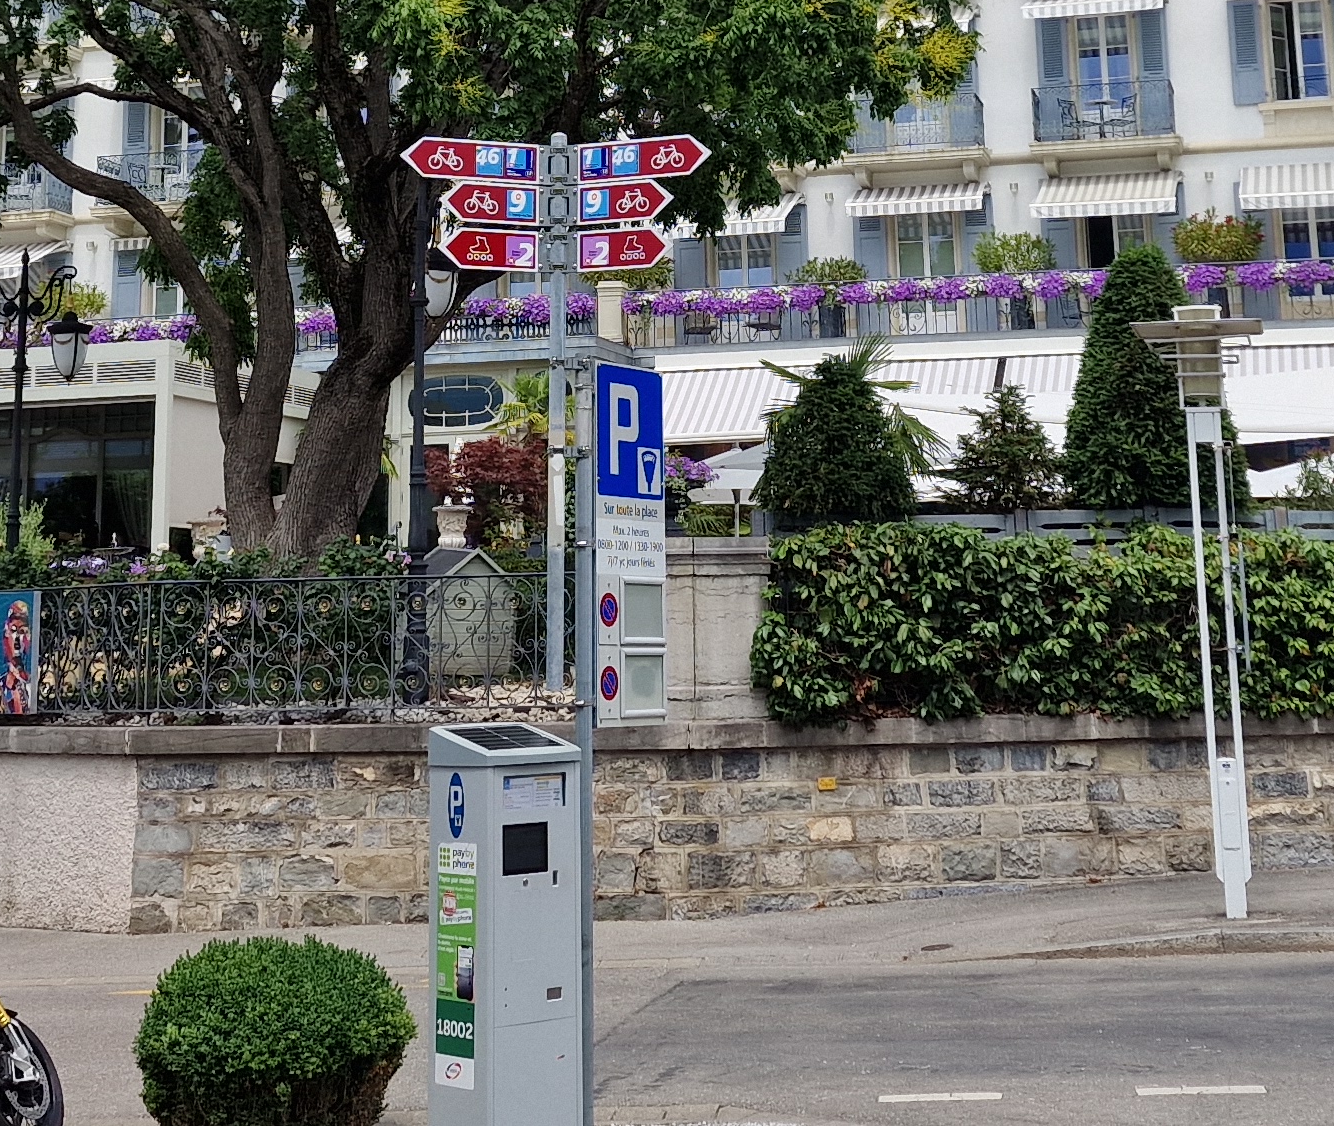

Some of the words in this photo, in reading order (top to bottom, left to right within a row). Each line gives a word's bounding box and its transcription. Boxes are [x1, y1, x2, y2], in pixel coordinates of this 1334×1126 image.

[476, 148, 500, 166] 46
[613, 146, 635, 165] 46
[509, 190, 527, 213] 9
[585, 190, 602, 213] 9
[515, 242, 534, 267] 2
[592, 241, 609, 266] 2
[609, 382, 640, 476] P
[604, 502, 615, 515] Sur
[616, 504, 633, 517] toute
[634, 503, 641, 517] la
[642, 504, 658, 520] place
[632, 526, 650, 538] heures
[450, 785, 463, 819] P
[452, 859, 475, 870] phone
[437, 1018, 473, 1040] 18002
